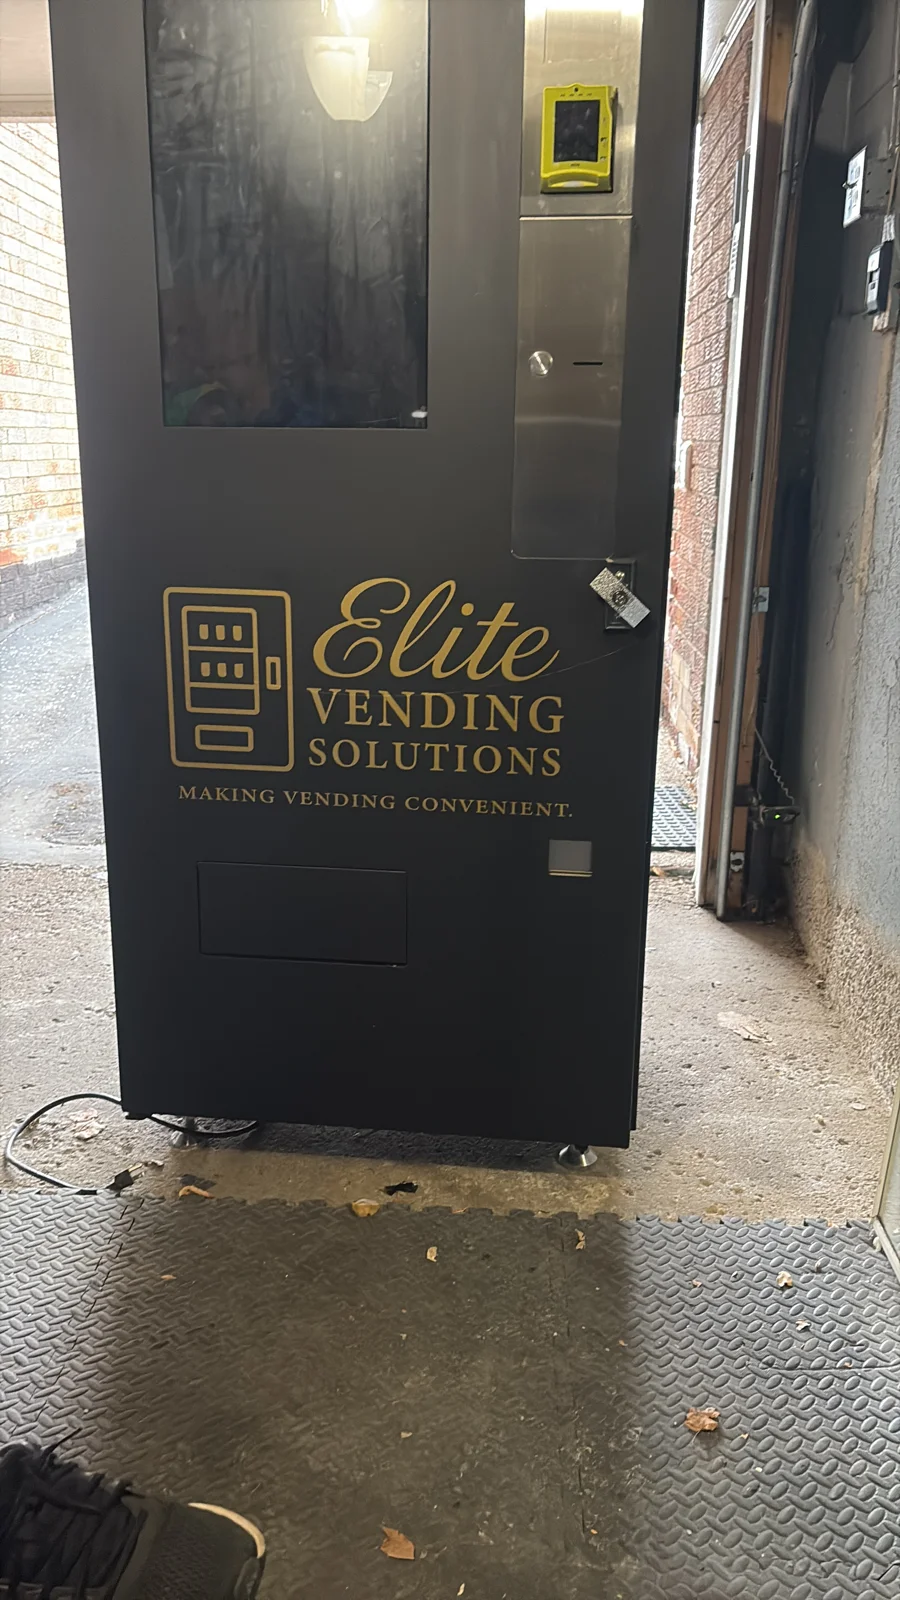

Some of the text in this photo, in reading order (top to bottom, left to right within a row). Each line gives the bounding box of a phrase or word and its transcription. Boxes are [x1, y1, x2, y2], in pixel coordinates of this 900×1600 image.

[312, 577, 560, 682] Elite
[306, 687, 565, 734] VENDING
[308, 738, 562, 777] SOLUTIONS
[178, 785, 573, 818] MAKING VENDING CONVENIENT.
